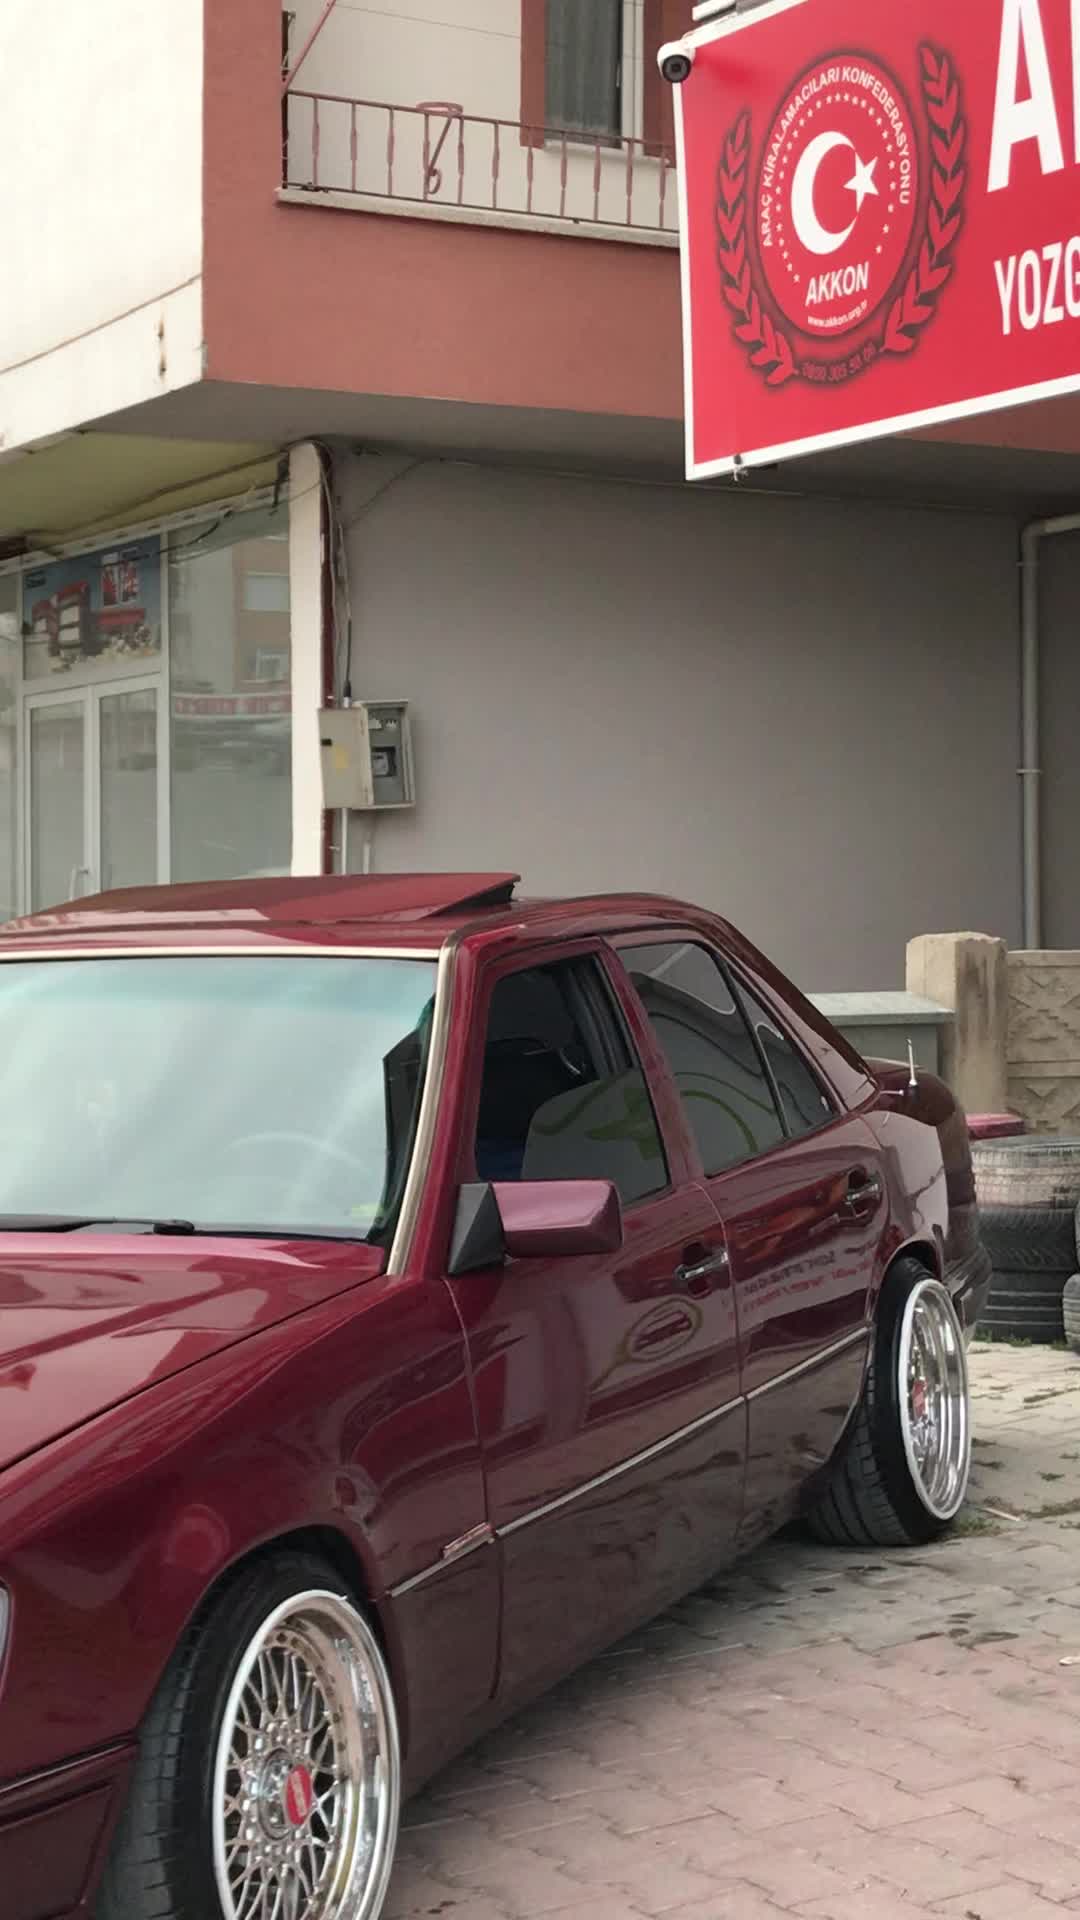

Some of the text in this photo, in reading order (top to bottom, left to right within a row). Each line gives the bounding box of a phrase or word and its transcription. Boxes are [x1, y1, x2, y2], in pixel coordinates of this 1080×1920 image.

[761, 194, 773, 246] ARAÇ
[841, 66, 910, 205] KONFEDERASYONU
[805, 261, 869, 307] AKKON
